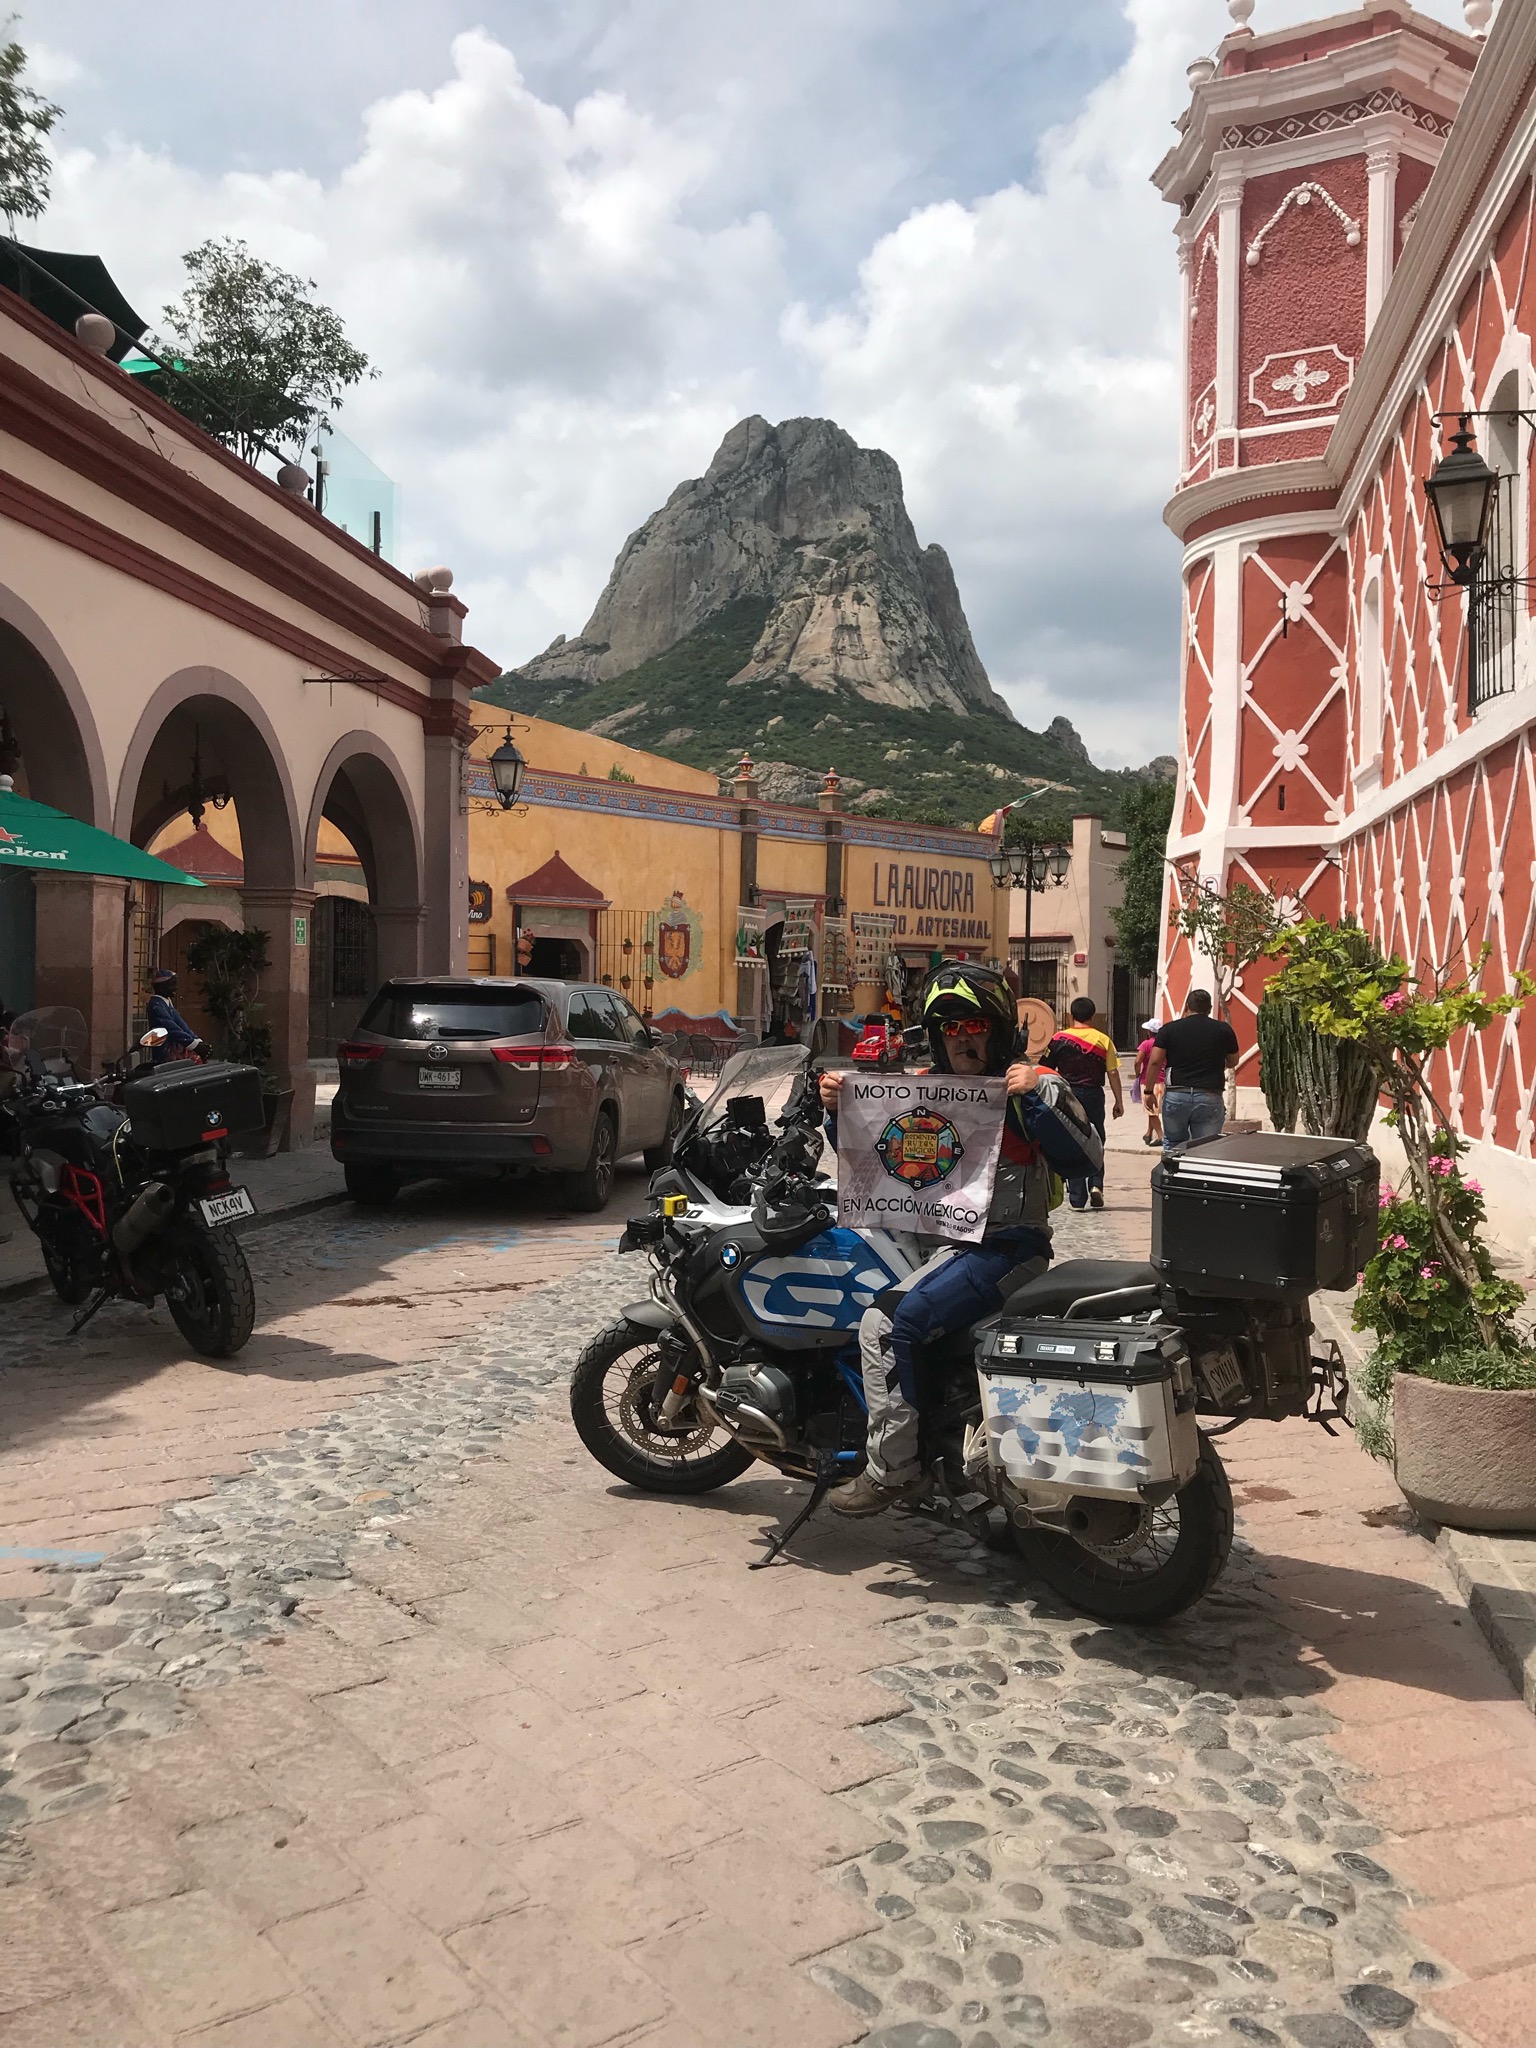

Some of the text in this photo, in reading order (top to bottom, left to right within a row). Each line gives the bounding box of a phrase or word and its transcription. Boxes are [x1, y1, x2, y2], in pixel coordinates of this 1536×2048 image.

[903, 865, 974, 914] AURORA
[916, 916, 991, 939] ARTESANAL
[854, 1084, 988, 1103] MOTO TURISTA
[208, 1196, 243, 1218] NCK4V
[843, 1196, 979, 1224] EN ACCIÓN MÉXICO
